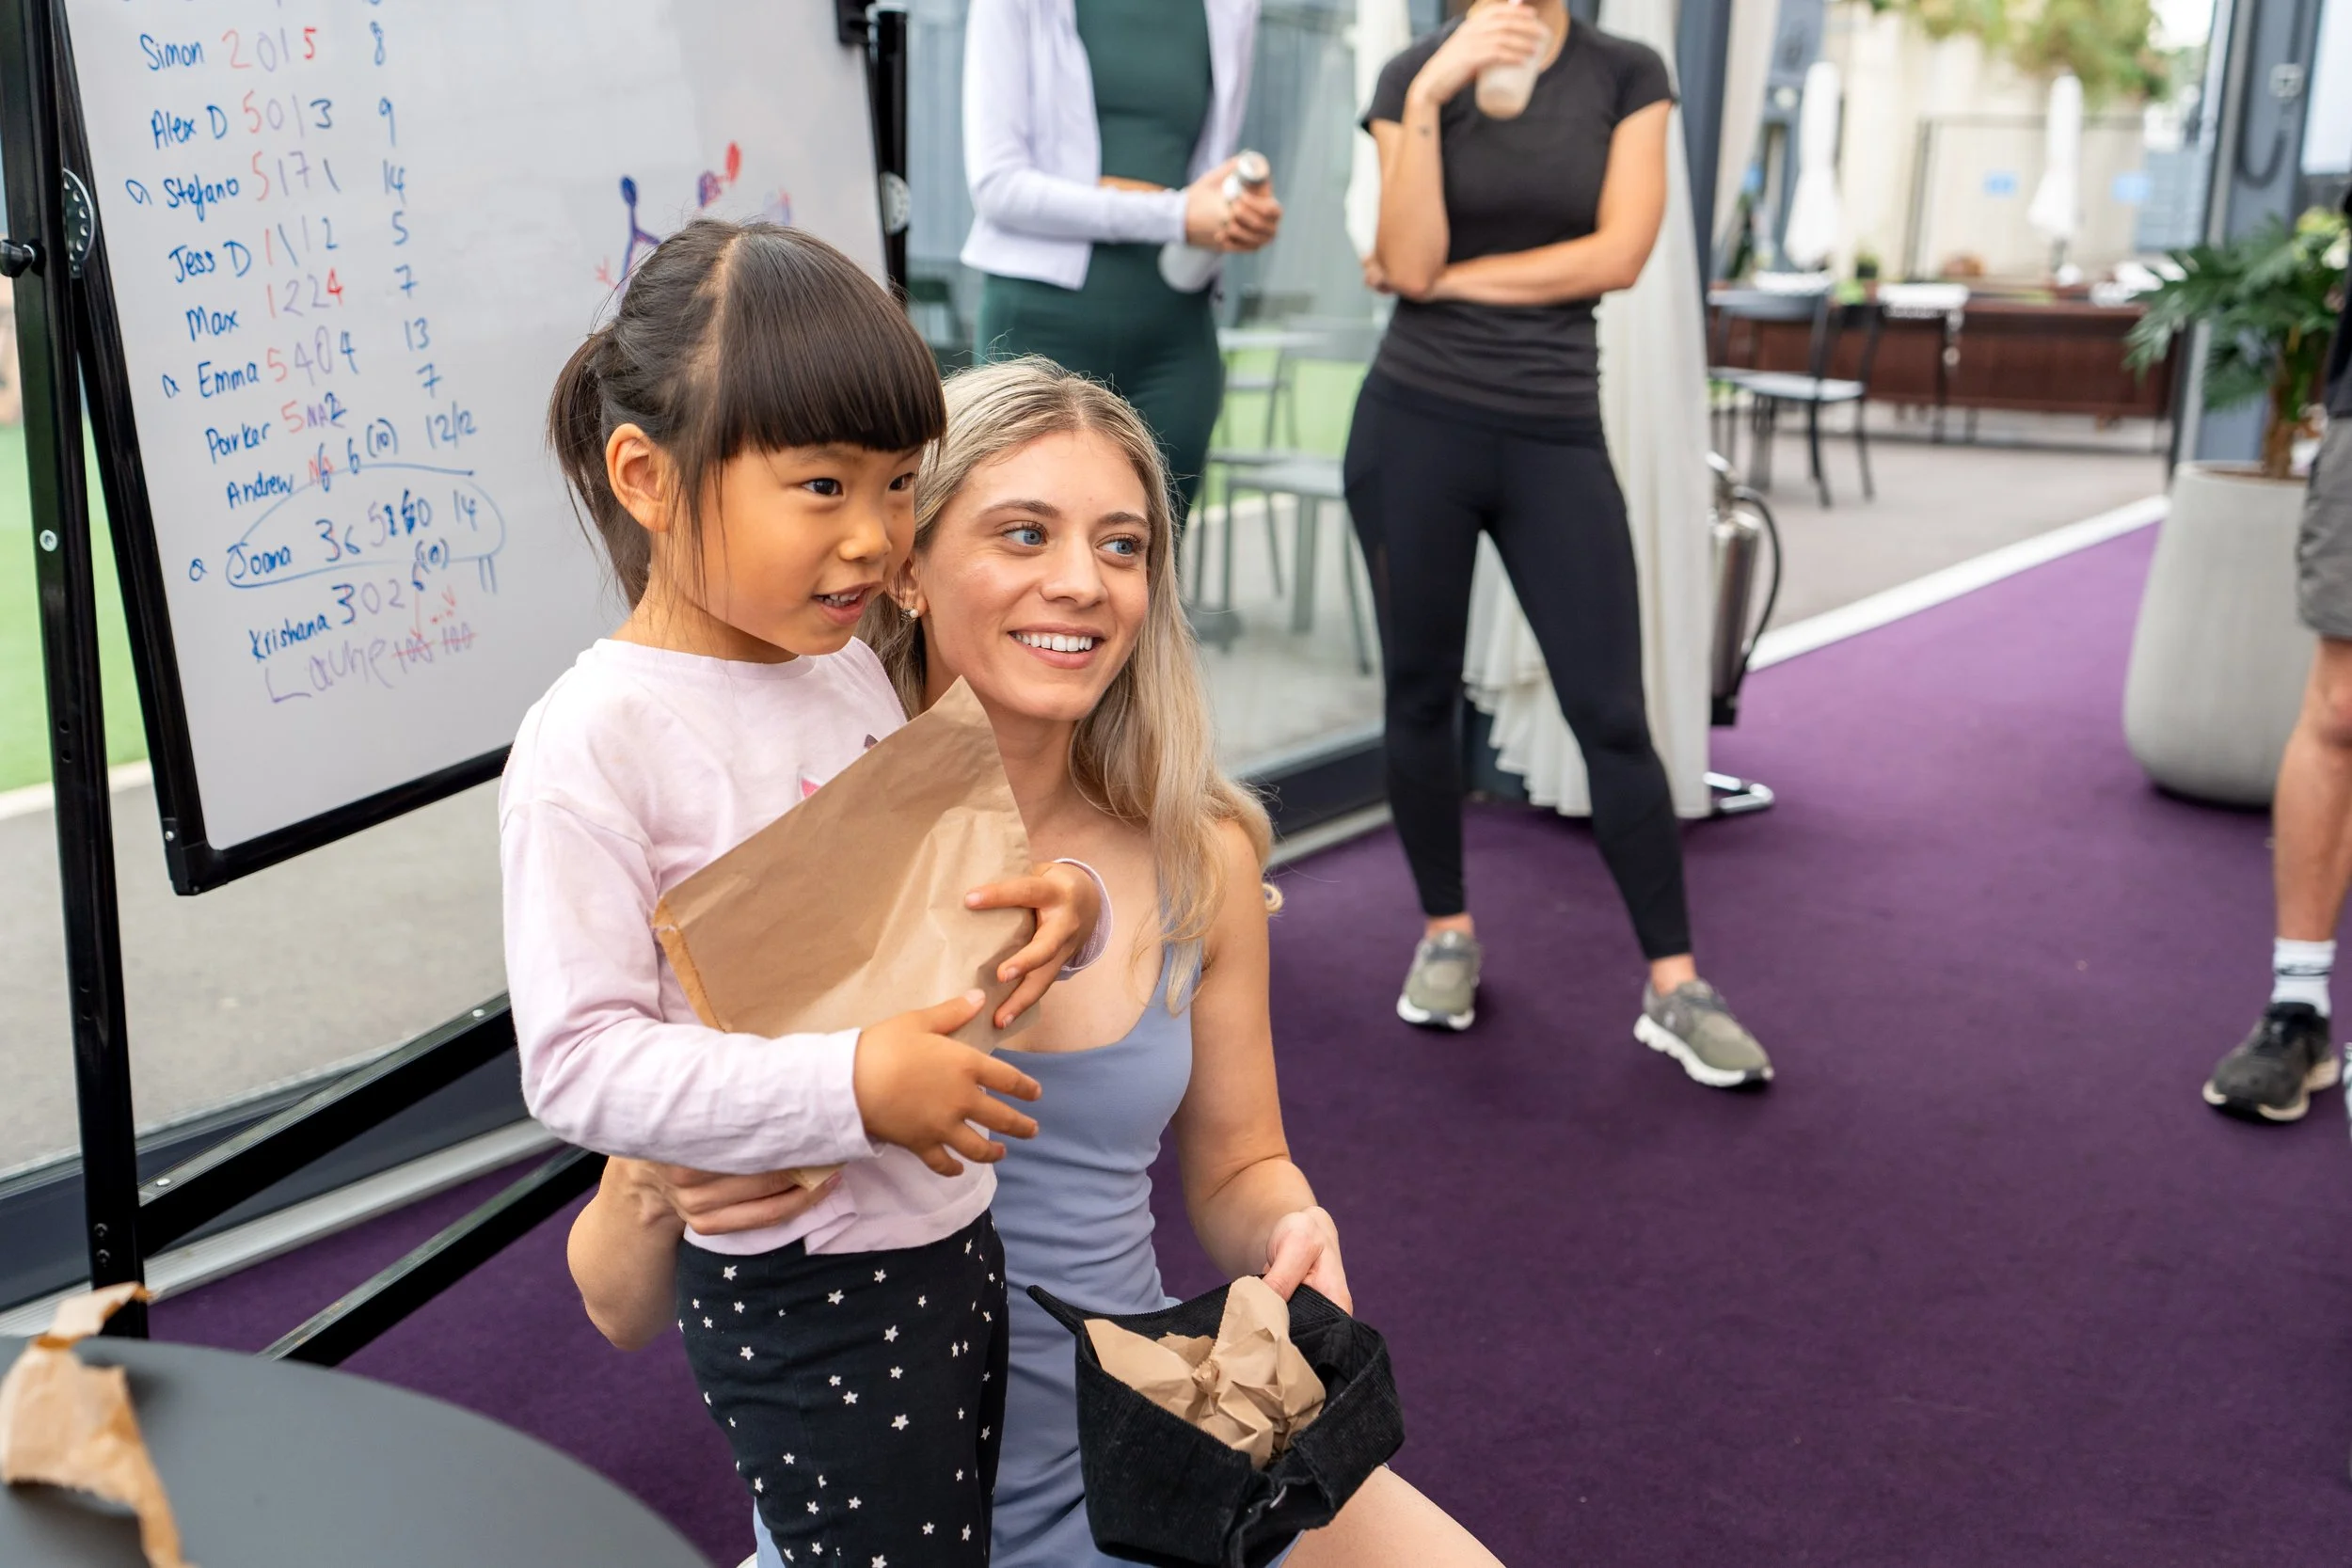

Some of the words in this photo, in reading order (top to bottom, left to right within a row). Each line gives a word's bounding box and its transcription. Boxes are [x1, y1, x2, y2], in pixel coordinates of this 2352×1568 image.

[140, 34, 204, 71] Simon
[151, 109, 196, 149] Alex
[207, 104, 228, 139] D
[164, 173, 239, 222] Stefano
[168, 245, 215, 283] Jess
[223, 240, 251, 277] D
[393, 211, 409, 245] 5
[186, 306, 239, 341] Max
[198, 360, 260, 399] Emma
[205, 422, 271, 465] Parker
[227, 470, 294, 509] Andrew
